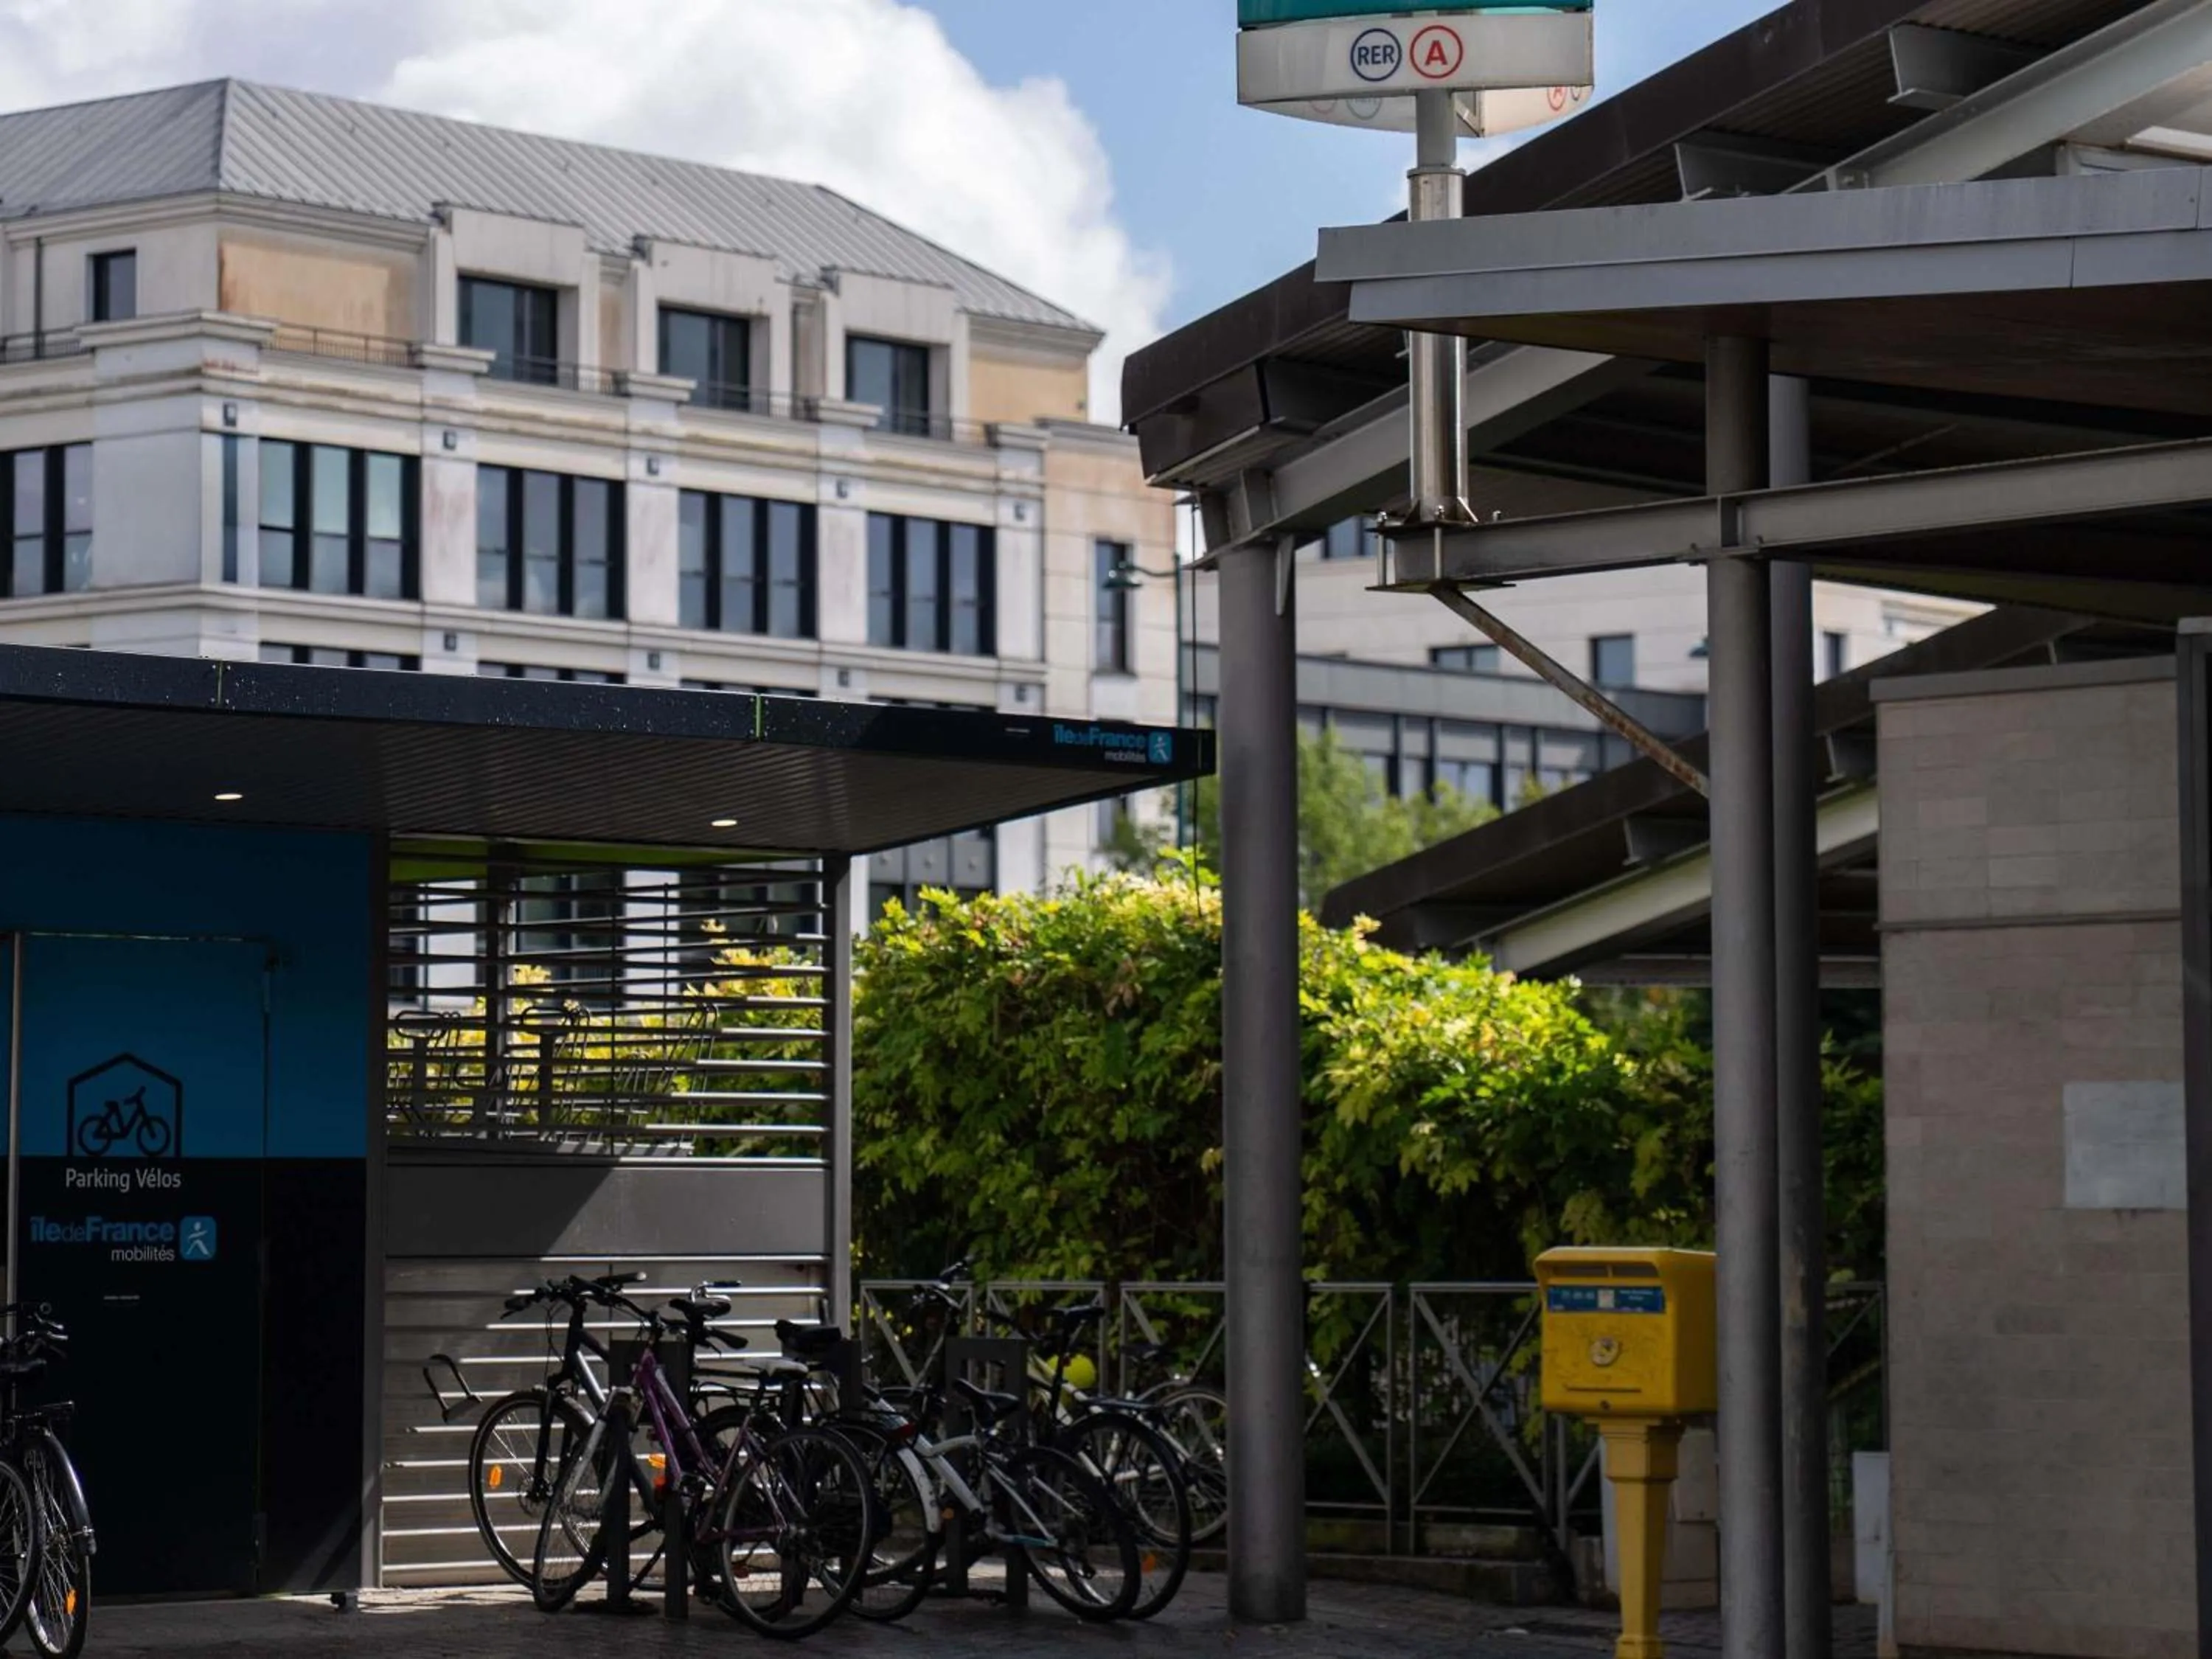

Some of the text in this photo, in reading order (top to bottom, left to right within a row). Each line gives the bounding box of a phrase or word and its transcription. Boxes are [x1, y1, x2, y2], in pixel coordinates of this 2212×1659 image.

[1357, 40, 1448, 66] RER A
[65, 1167, 181, 1193] Parking Vélos
[111, 1244, 175, 1262] mobilités
